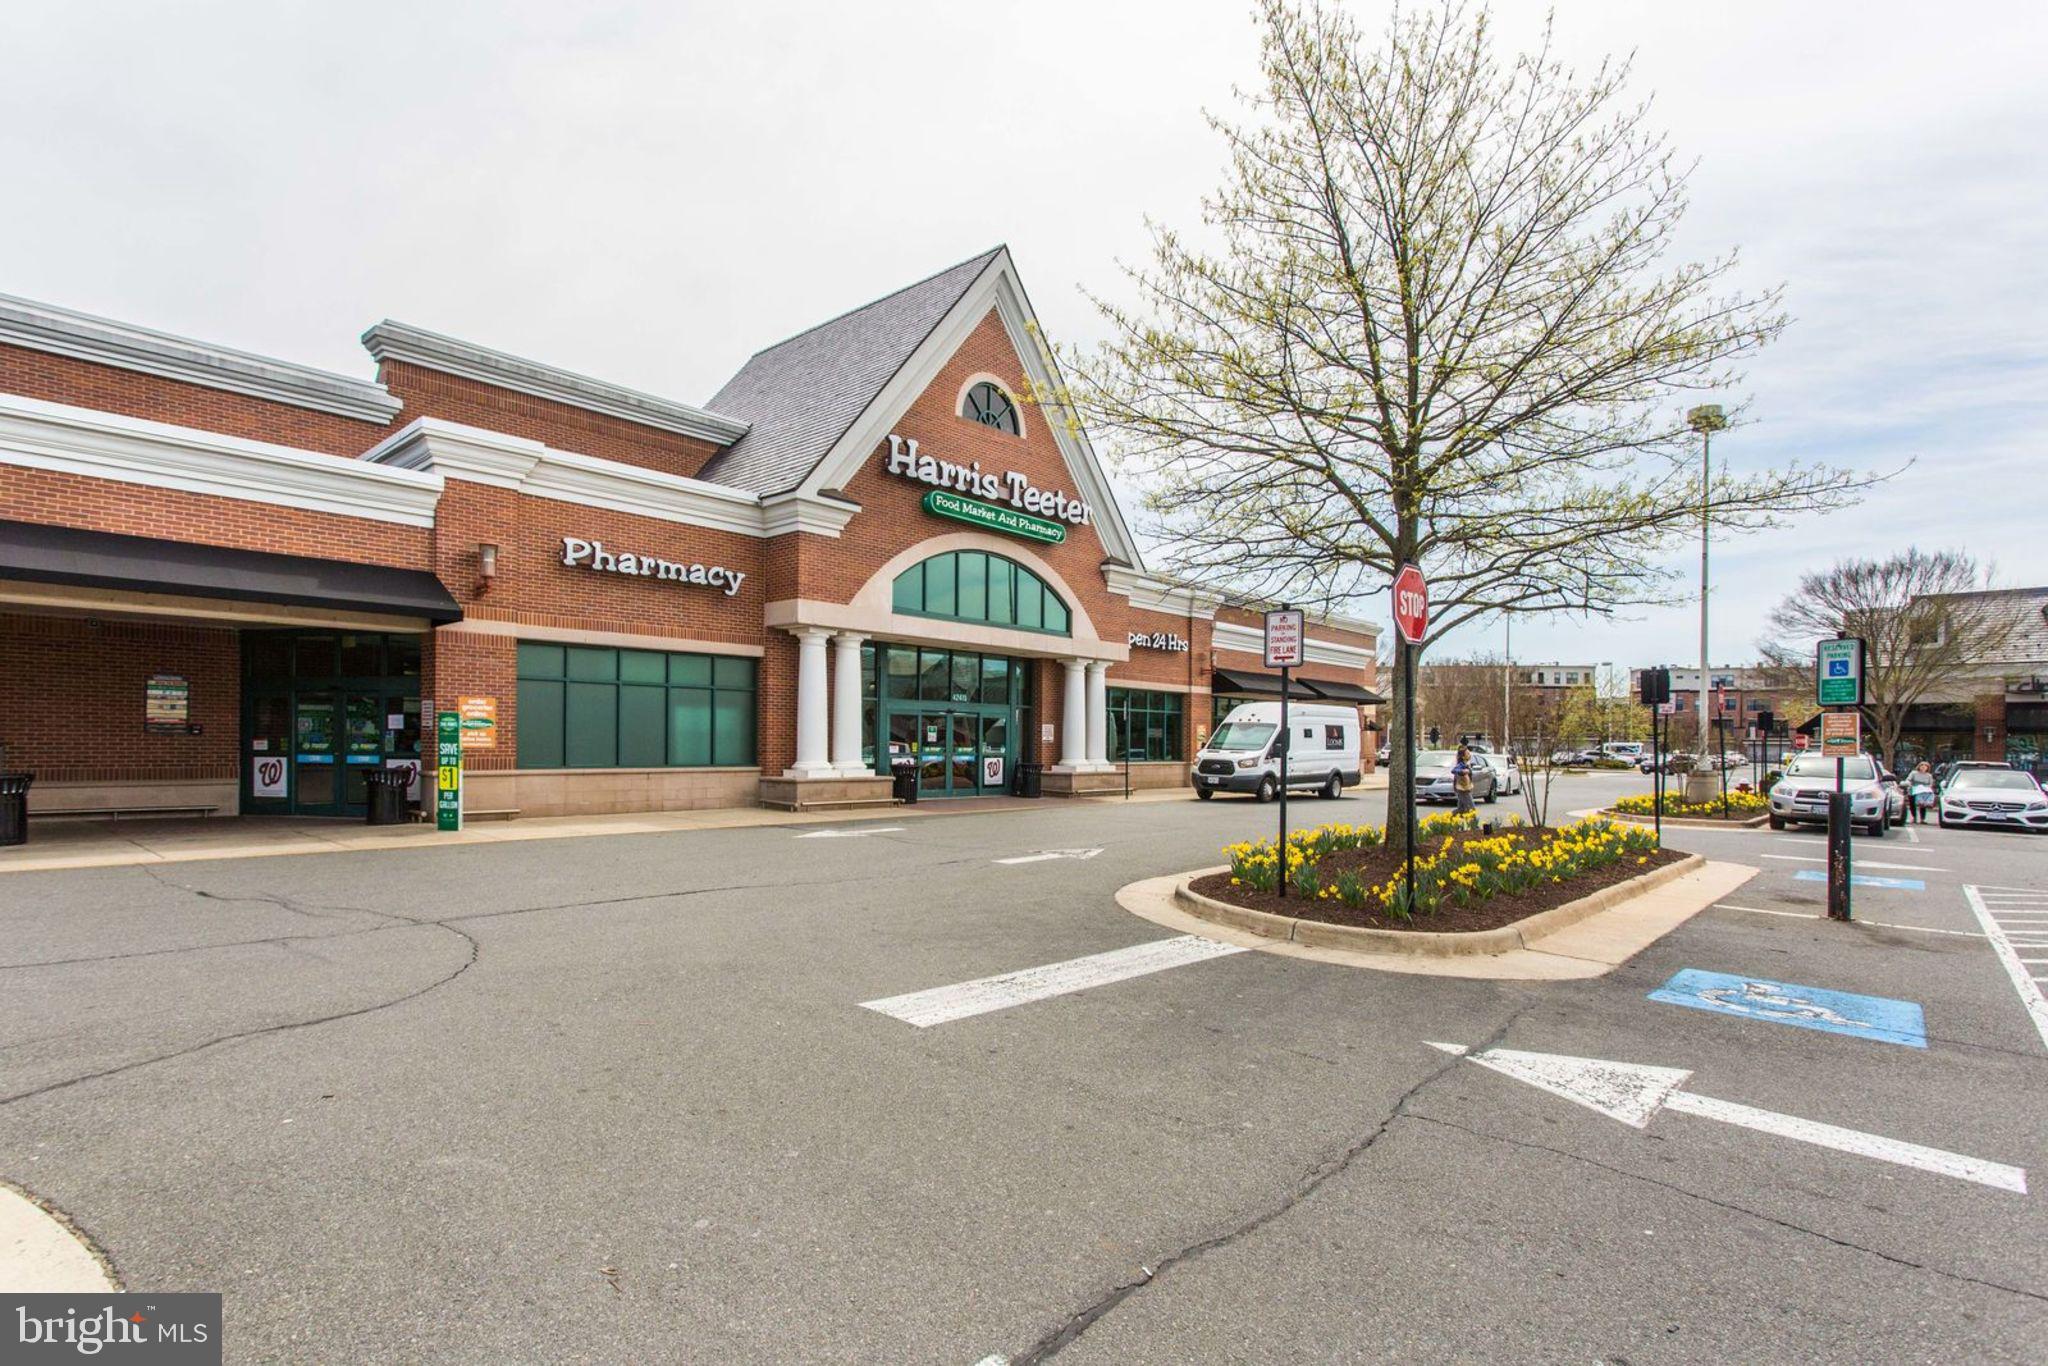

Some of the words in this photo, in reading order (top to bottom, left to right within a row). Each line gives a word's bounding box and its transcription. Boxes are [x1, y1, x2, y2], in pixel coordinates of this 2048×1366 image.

[887, 434, 999, 500] Harris
[1006, 470, 1092, 526] Teeter
[936, 495, 960, 512] Food
[962, 502, 996, 520] Market
[998, 513, 1018, 527] And
[1019, 518, 1063, 539] Pharmacy
[562, 537, 746, 596] Pharmacy
[1400, 590, 1425, 619] STOP
[1279, 615, 1289, 623] NO
[1271, 624, 1297, 632] PARKING
[1128, 632, 1151, 650] pen
[1152, 632, 1167, 650] 24
[1168, 633, 1189, 652] Hrs
[1270, 636, 1297, 644] STANDING
[1823, 643, 1855, 651] RESERVED
[1270, 646, 1281, 654] FIRE
[1283, 645, 1297, 654] LANE
[440, 743, 458, 756] SAVE
[442, 767, 453, 789] $1
